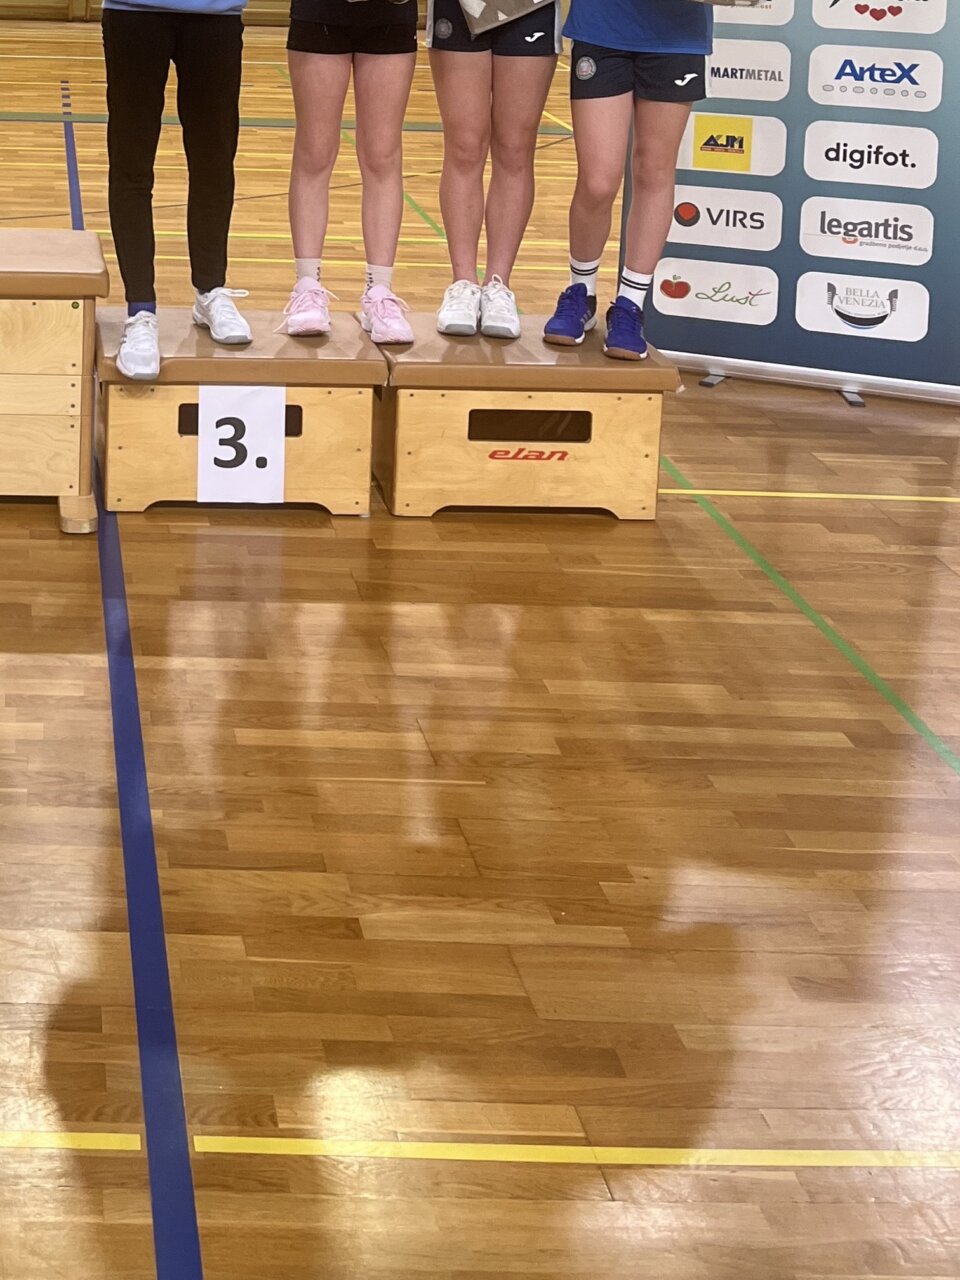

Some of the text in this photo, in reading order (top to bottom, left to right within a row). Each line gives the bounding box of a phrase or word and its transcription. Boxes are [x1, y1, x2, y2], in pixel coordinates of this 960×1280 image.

[824, 142, 917, 170] digifot.
[706, 207, 765, 230] VIRS
[820, 210, 914, 242] legartis
[695, 281, 772, 307] Lust
[838, 295, 886, 309] VENEZIA
[845, 287, 880, 299] BELLA
[213, 417, 268, 469] 3.
[488, 447, 569, 461] elan
